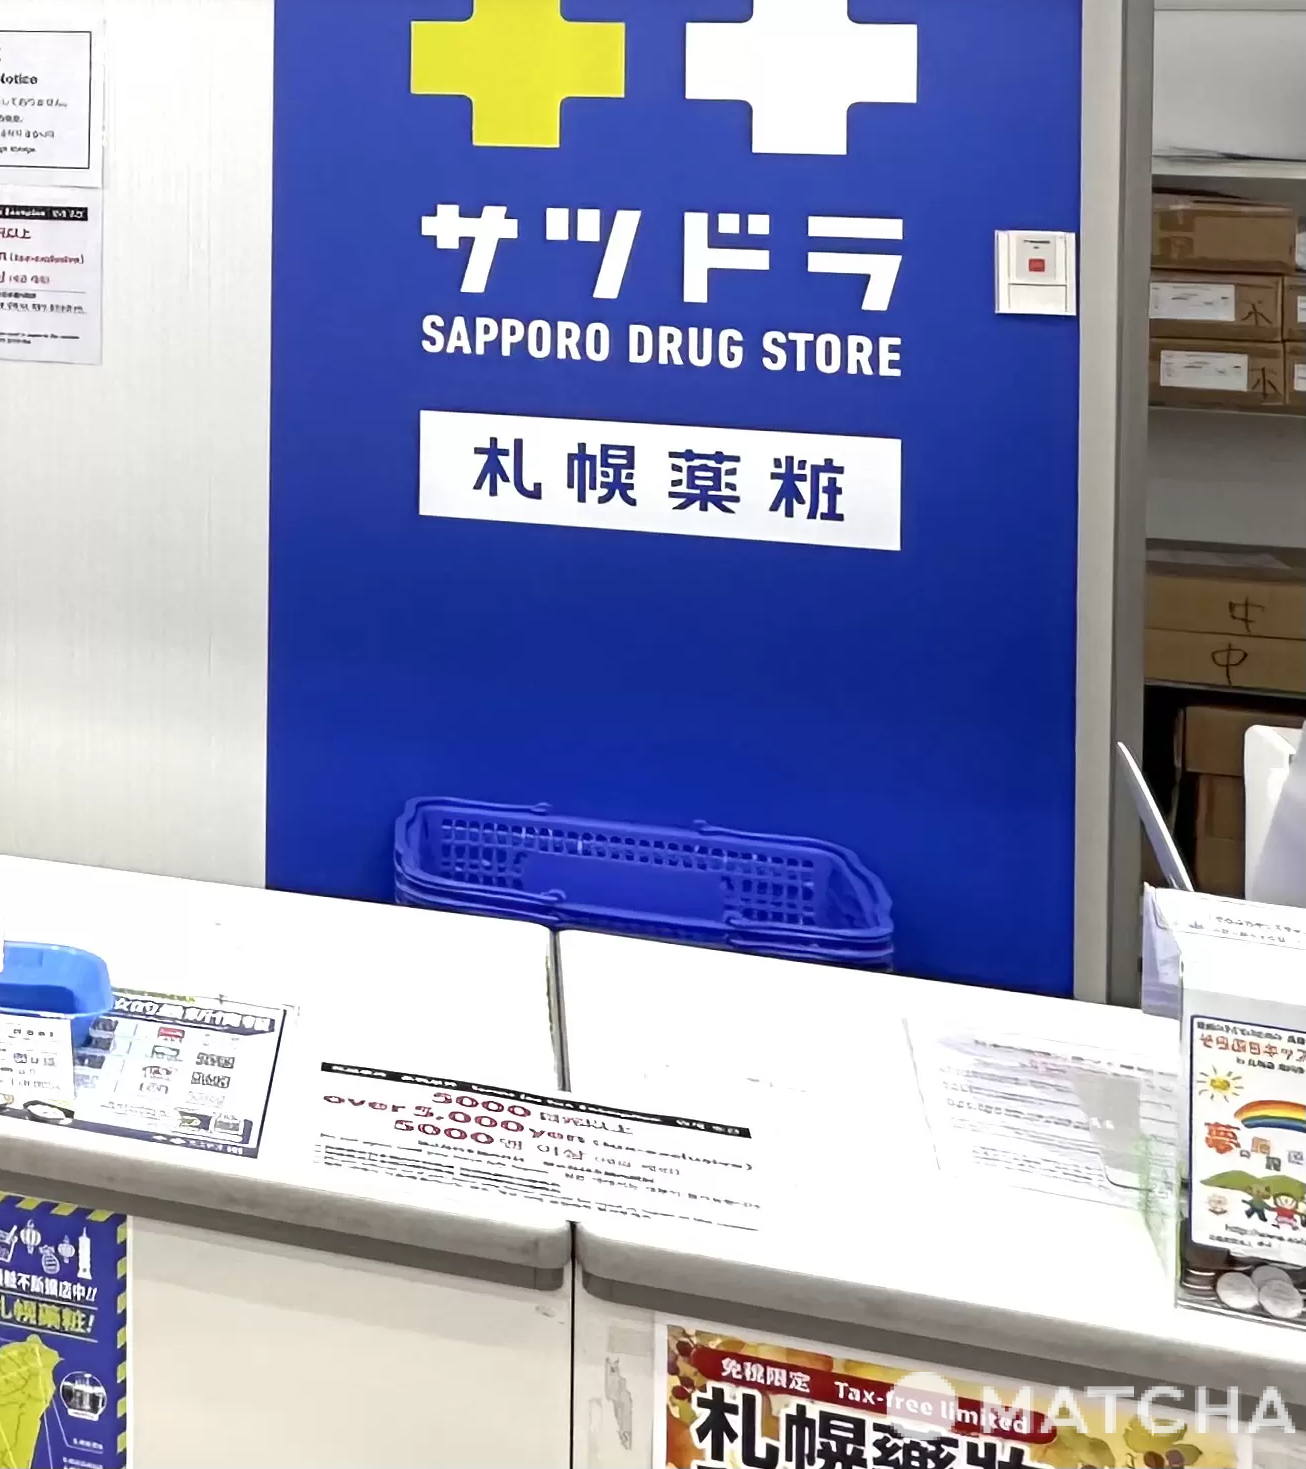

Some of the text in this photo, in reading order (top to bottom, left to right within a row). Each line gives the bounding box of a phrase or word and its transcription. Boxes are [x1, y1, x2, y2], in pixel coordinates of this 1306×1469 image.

[421, 203, 904, 311] サツドラ
[420, 314, 902, 377] SAPPORO DRUG STORE
[472, 436, 845, 524] 札幌薬粧
